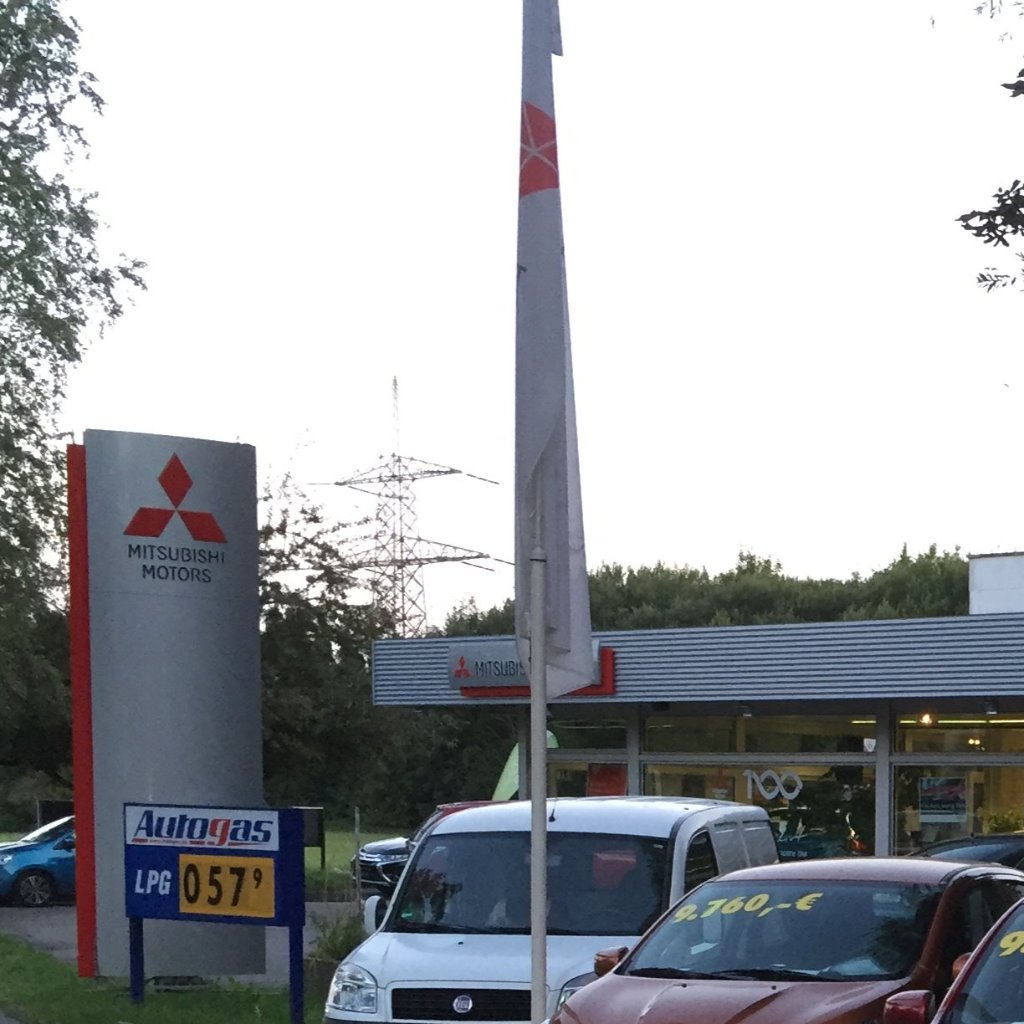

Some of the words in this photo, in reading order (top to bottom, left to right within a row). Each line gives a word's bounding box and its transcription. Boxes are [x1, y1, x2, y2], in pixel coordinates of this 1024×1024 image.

[127, 543, 225, 564] MITSUBISHI
[142, 564, 212, 584] MOTORS
[474, 660, 527, 678] MITSUBIS
[133, 809, 274, 847] Autogas
[134, 869, 173, 896] LPG
